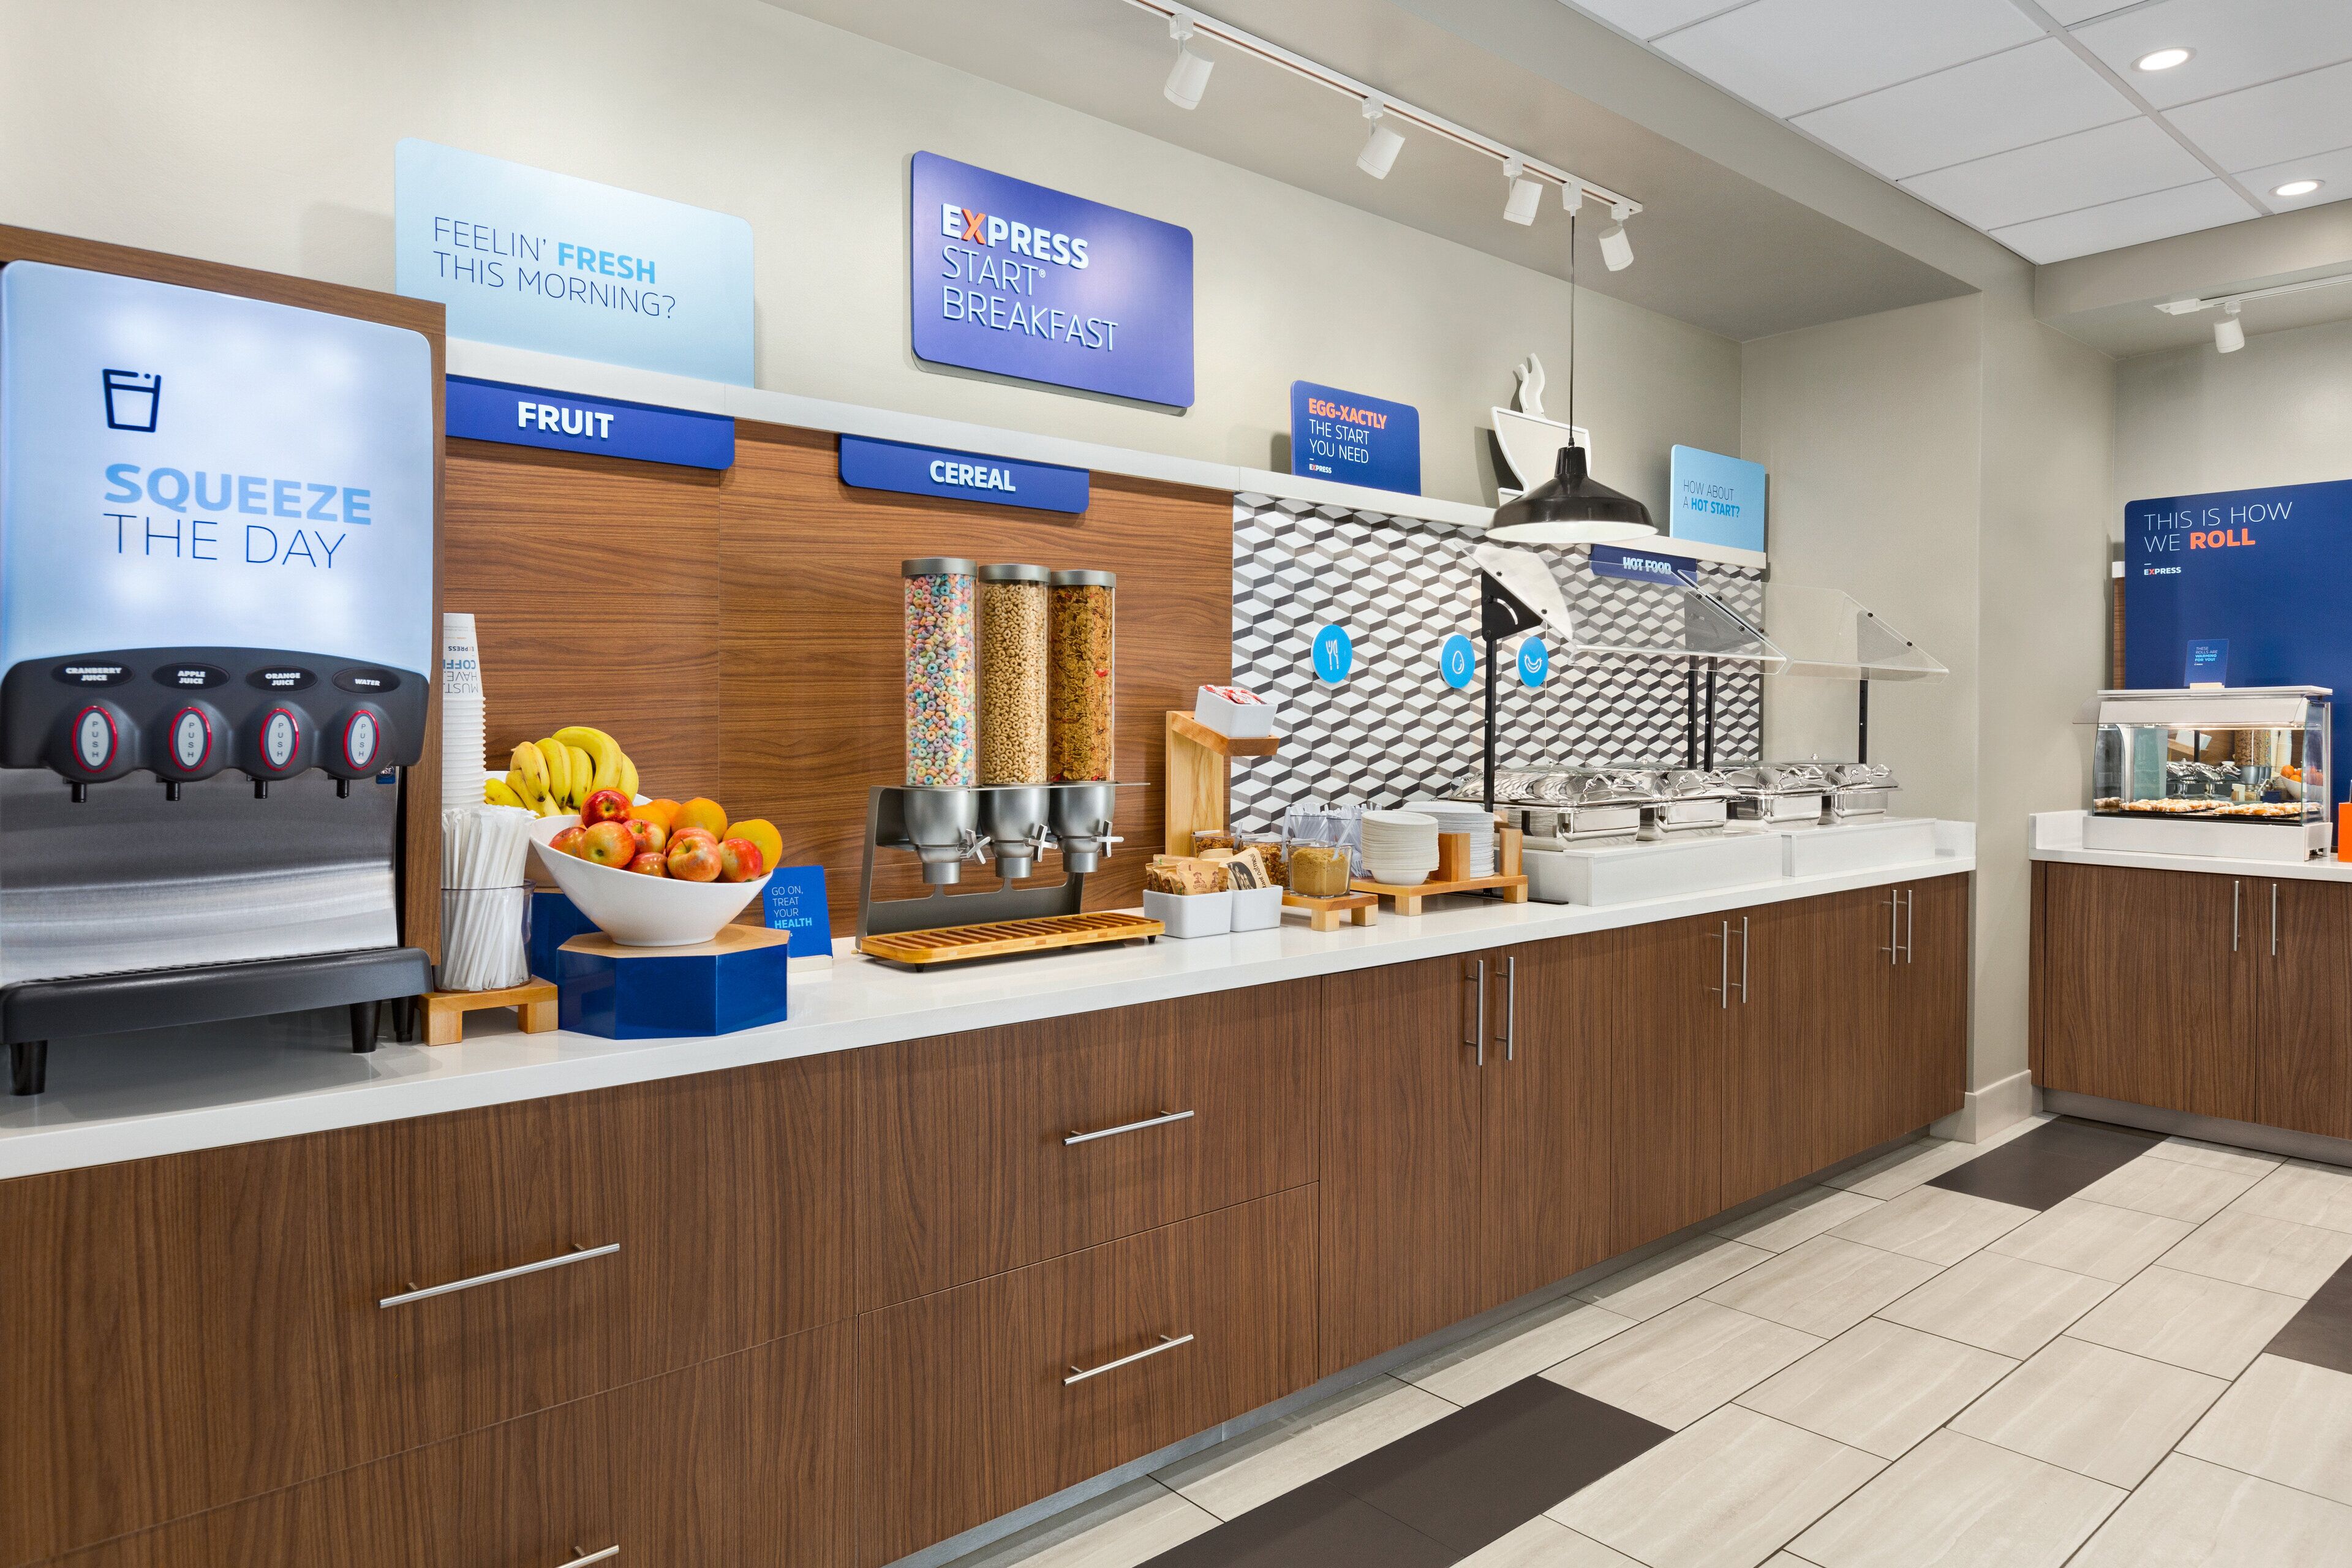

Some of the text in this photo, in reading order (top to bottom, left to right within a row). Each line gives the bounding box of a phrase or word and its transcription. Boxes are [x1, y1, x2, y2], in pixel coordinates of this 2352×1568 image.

[941, 203, 1089, 270] EXPRESS
[558, 242, 656, 284] FRESH
[432, 251, 676, 319] THIS MORNING?
[942, 285, 1118, 352] BREAKFAST
[518, 401, 614, 439] FRUIT
[1308, 398, 1387, 429] EGG-XACTLY
[1309, 418, 1370, 445] THE START
[1309, 438, 1369, 464] YOU NEED
[929, 460, 1016, 492] CEREAL
[1309, 464, 1332, 473] EXPRESS
[105, 462, 372, 526] SQUEEZE
[1683, 479, 1734, 502] HOW ABOUT
[1683, 496, 1740, 518] A HOT START?
[2144, 502, 2293, 531] THIS IS HOW
[104, 513, 347, 569] THE DAY
[2144, 528, 2256, 552] WE ROLL
[1623, 556, 1672, 575] HOT FOOD
[2144, 567, 2182, 576] EXPRESS
[355, 678, 380, 687] WATER
[772, 886, 804, 895] GO ON,
[772, 896, 799, 907] TREAT
[774, 908, 799, 918] YOUR
[774, 918, 812, 929] HEALTH
